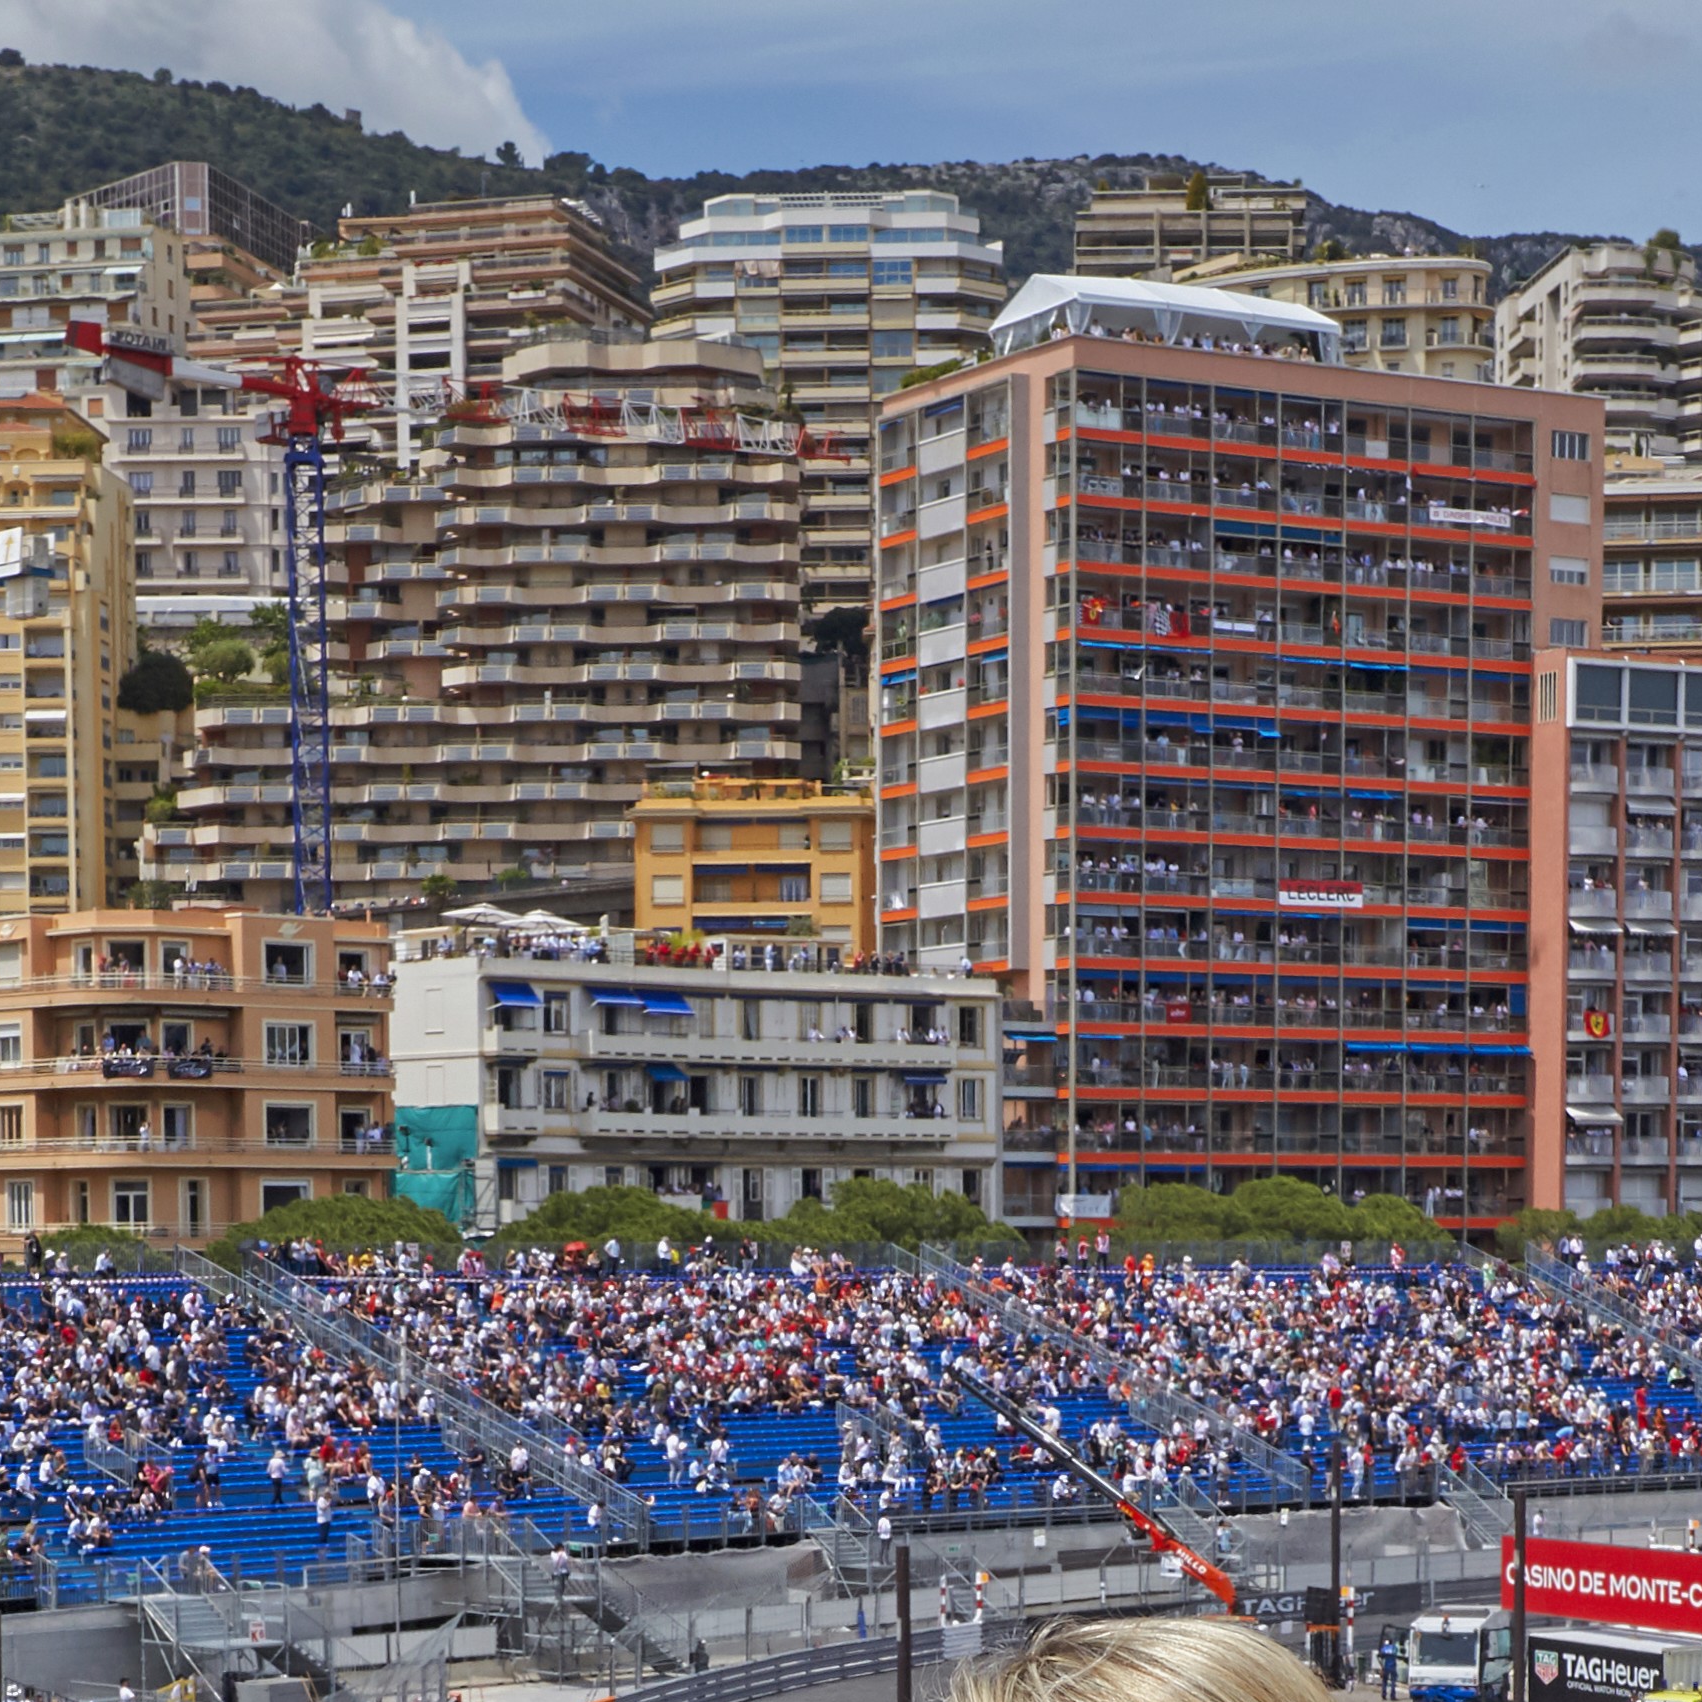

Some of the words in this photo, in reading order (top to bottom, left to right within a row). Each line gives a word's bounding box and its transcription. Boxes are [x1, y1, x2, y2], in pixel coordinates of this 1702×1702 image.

[1287, 884, 1356, 902] LECLERC
[1505, 1561, 1576, 1593] CASINO
[1579, 1571, 1607, 1596] DE
[1566, 1680, 1594, 1693] OFFICIAL
[1593, 1684, 1616, 1696] WATCH
